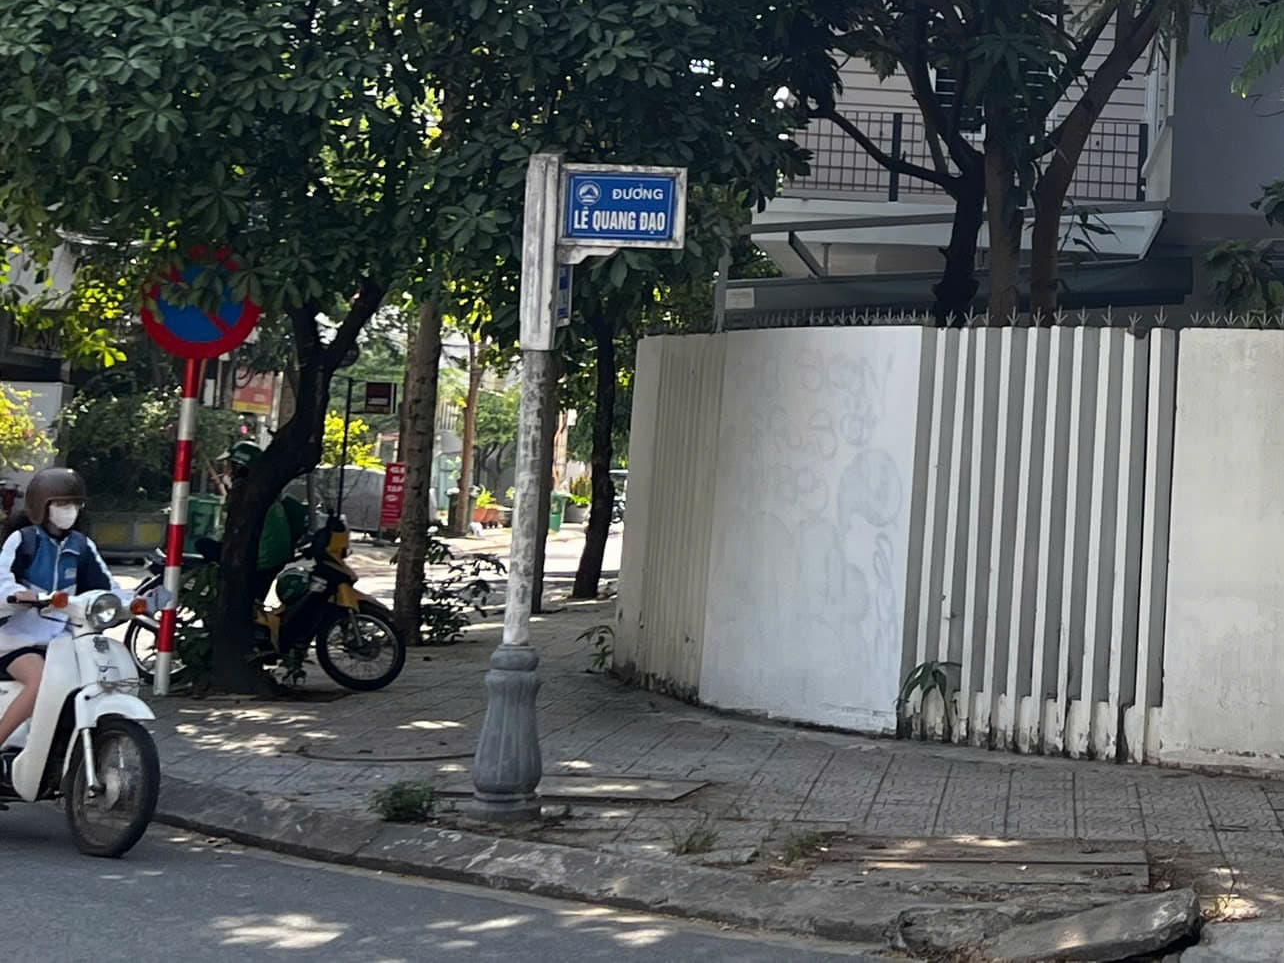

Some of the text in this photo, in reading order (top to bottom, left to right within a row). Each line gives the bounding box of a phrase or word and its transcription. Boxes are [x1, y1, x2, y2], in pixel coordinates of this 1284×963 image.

[611, 183, 664, 200] ĐƯỜNG
[573, 205, 666, 235] LÊ QUANG ĐẠO
